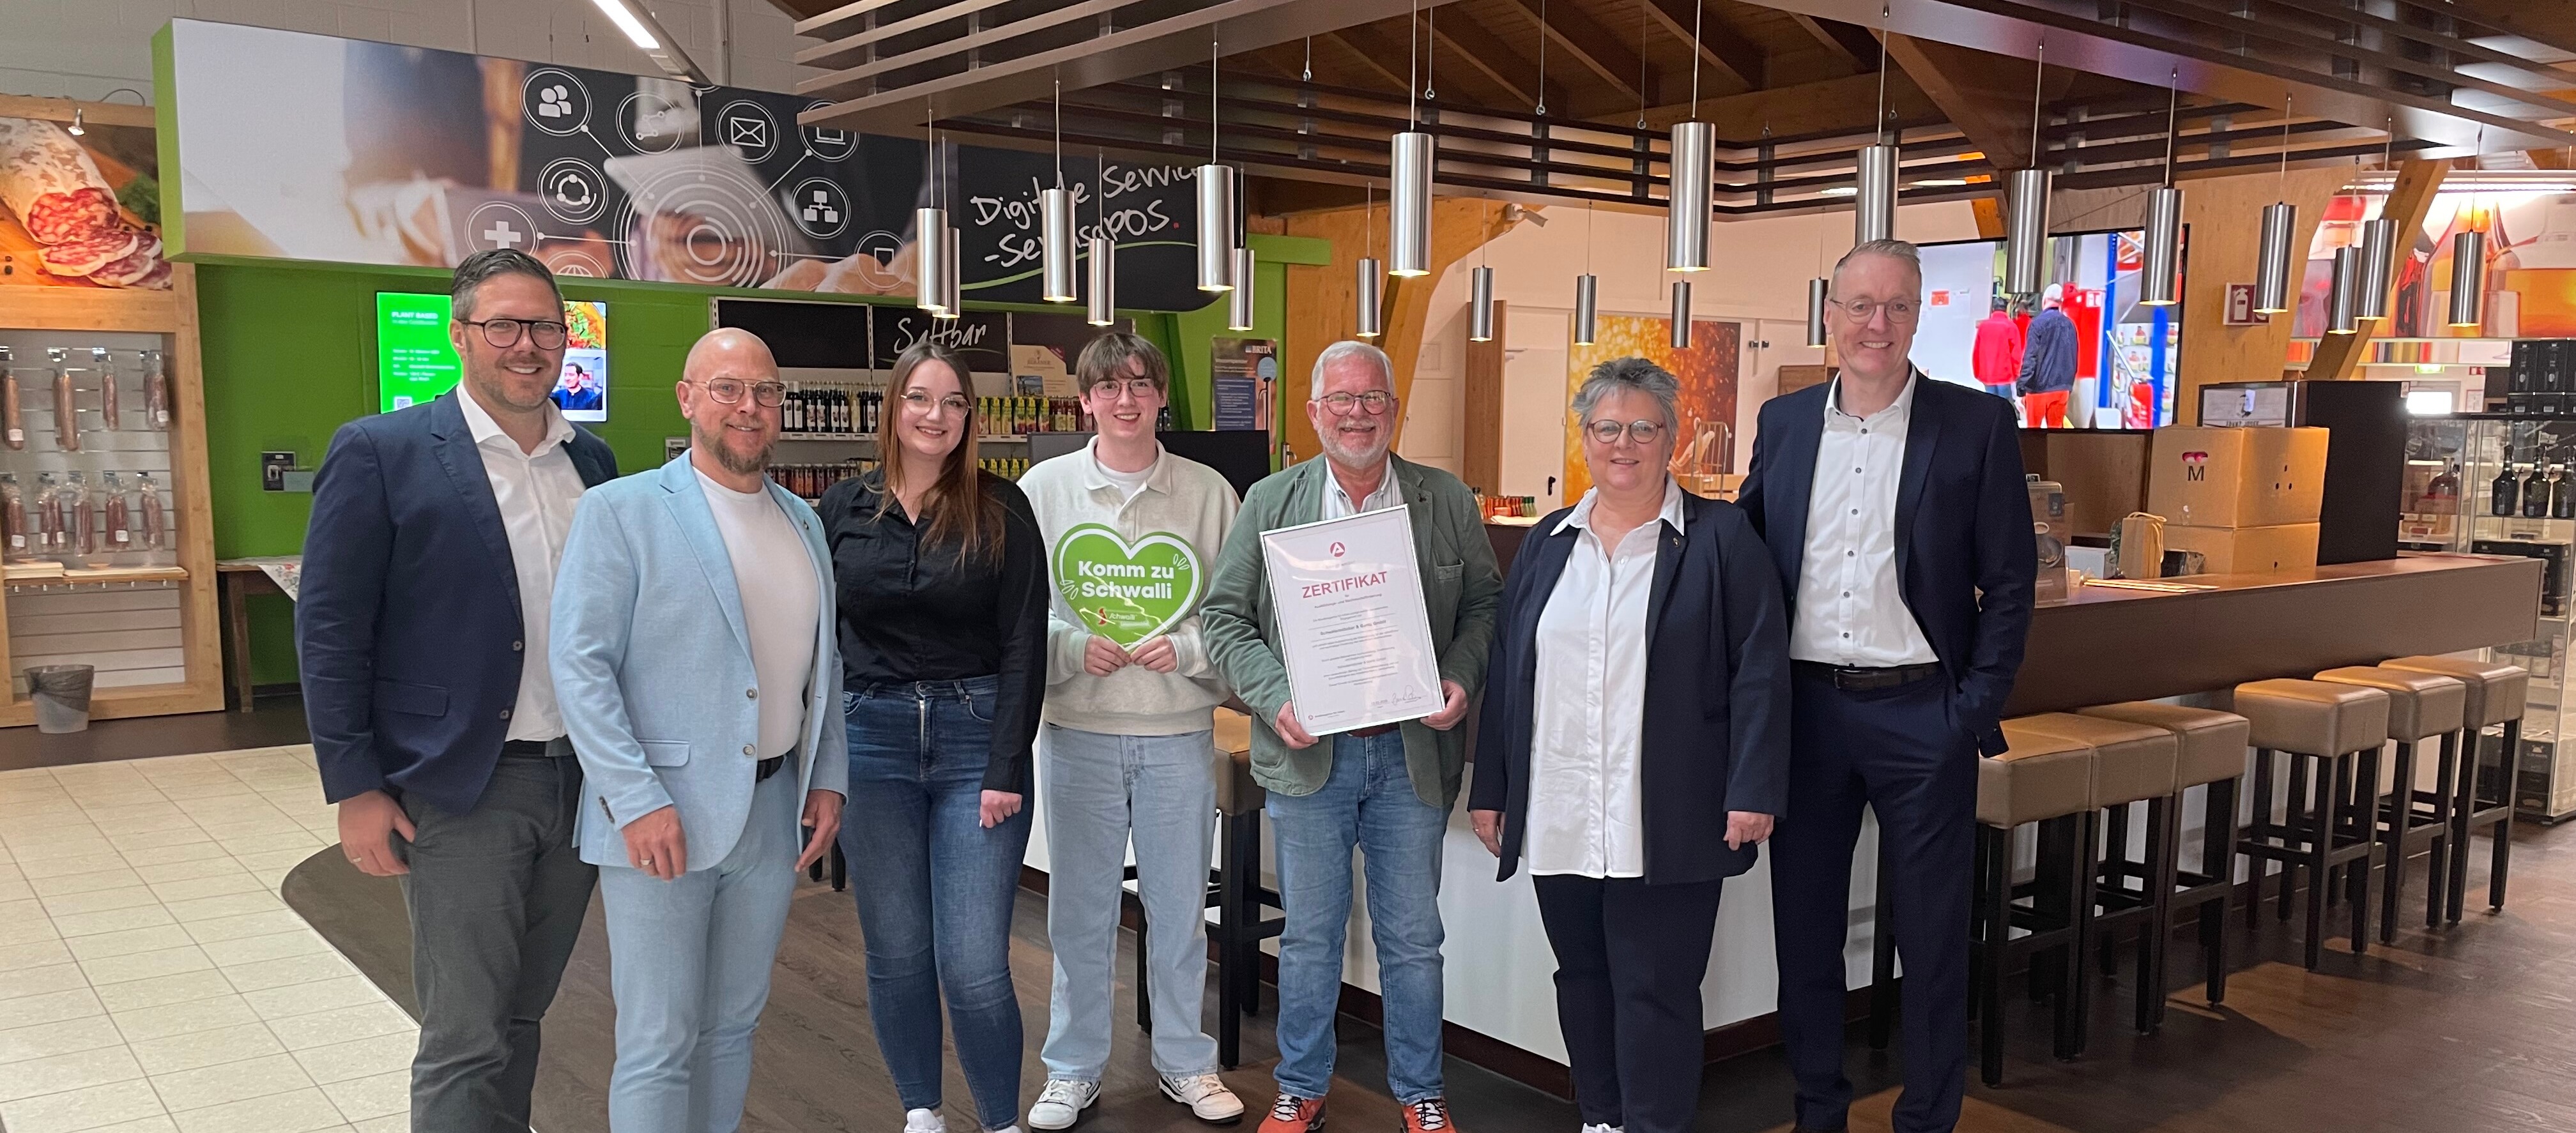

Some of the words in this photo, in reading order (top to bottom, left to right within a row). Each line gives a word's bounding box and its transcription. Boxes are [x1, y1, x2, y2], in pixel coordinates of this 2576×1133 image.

[970, 171, 1091, 230] Digite
[1252, 345, 1272, 354] BRITA
[2188, 466, 2204, 481] M
[1078, 560, 1146, 578] Komm
[1151, 565, 1174, 579] zu
[1081, 581, 1172, 599] Schwalli
[1301, 570, 1387, 598] ZERTIFIKAT
